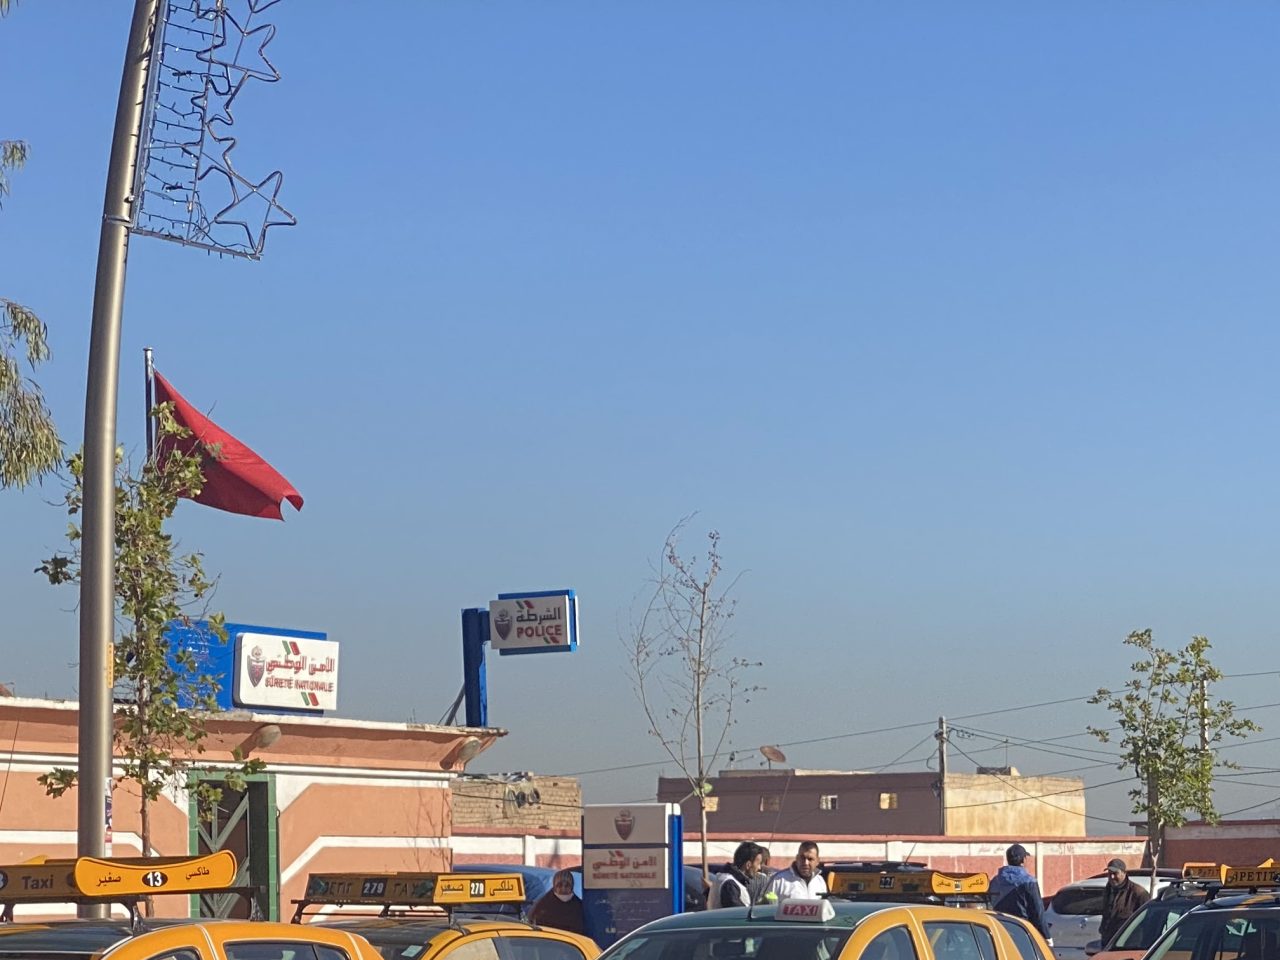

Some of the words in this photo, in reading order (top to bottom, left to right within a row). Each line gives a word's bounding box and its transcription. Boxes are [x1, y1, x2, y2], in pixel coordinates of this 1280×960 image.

[516, 607, 561, 625] الشرطة
[516, 625, 562, 638] POLICE
[294, 679, 334, 693] NATIONALE
[21, 874, 54, 890] Taxi
[96, 871, 122, 887] صغير
[147, 871, 163, 887] 13
[363, 882, 385, 894] 279
[785, 904, 818, 916] TAXI
